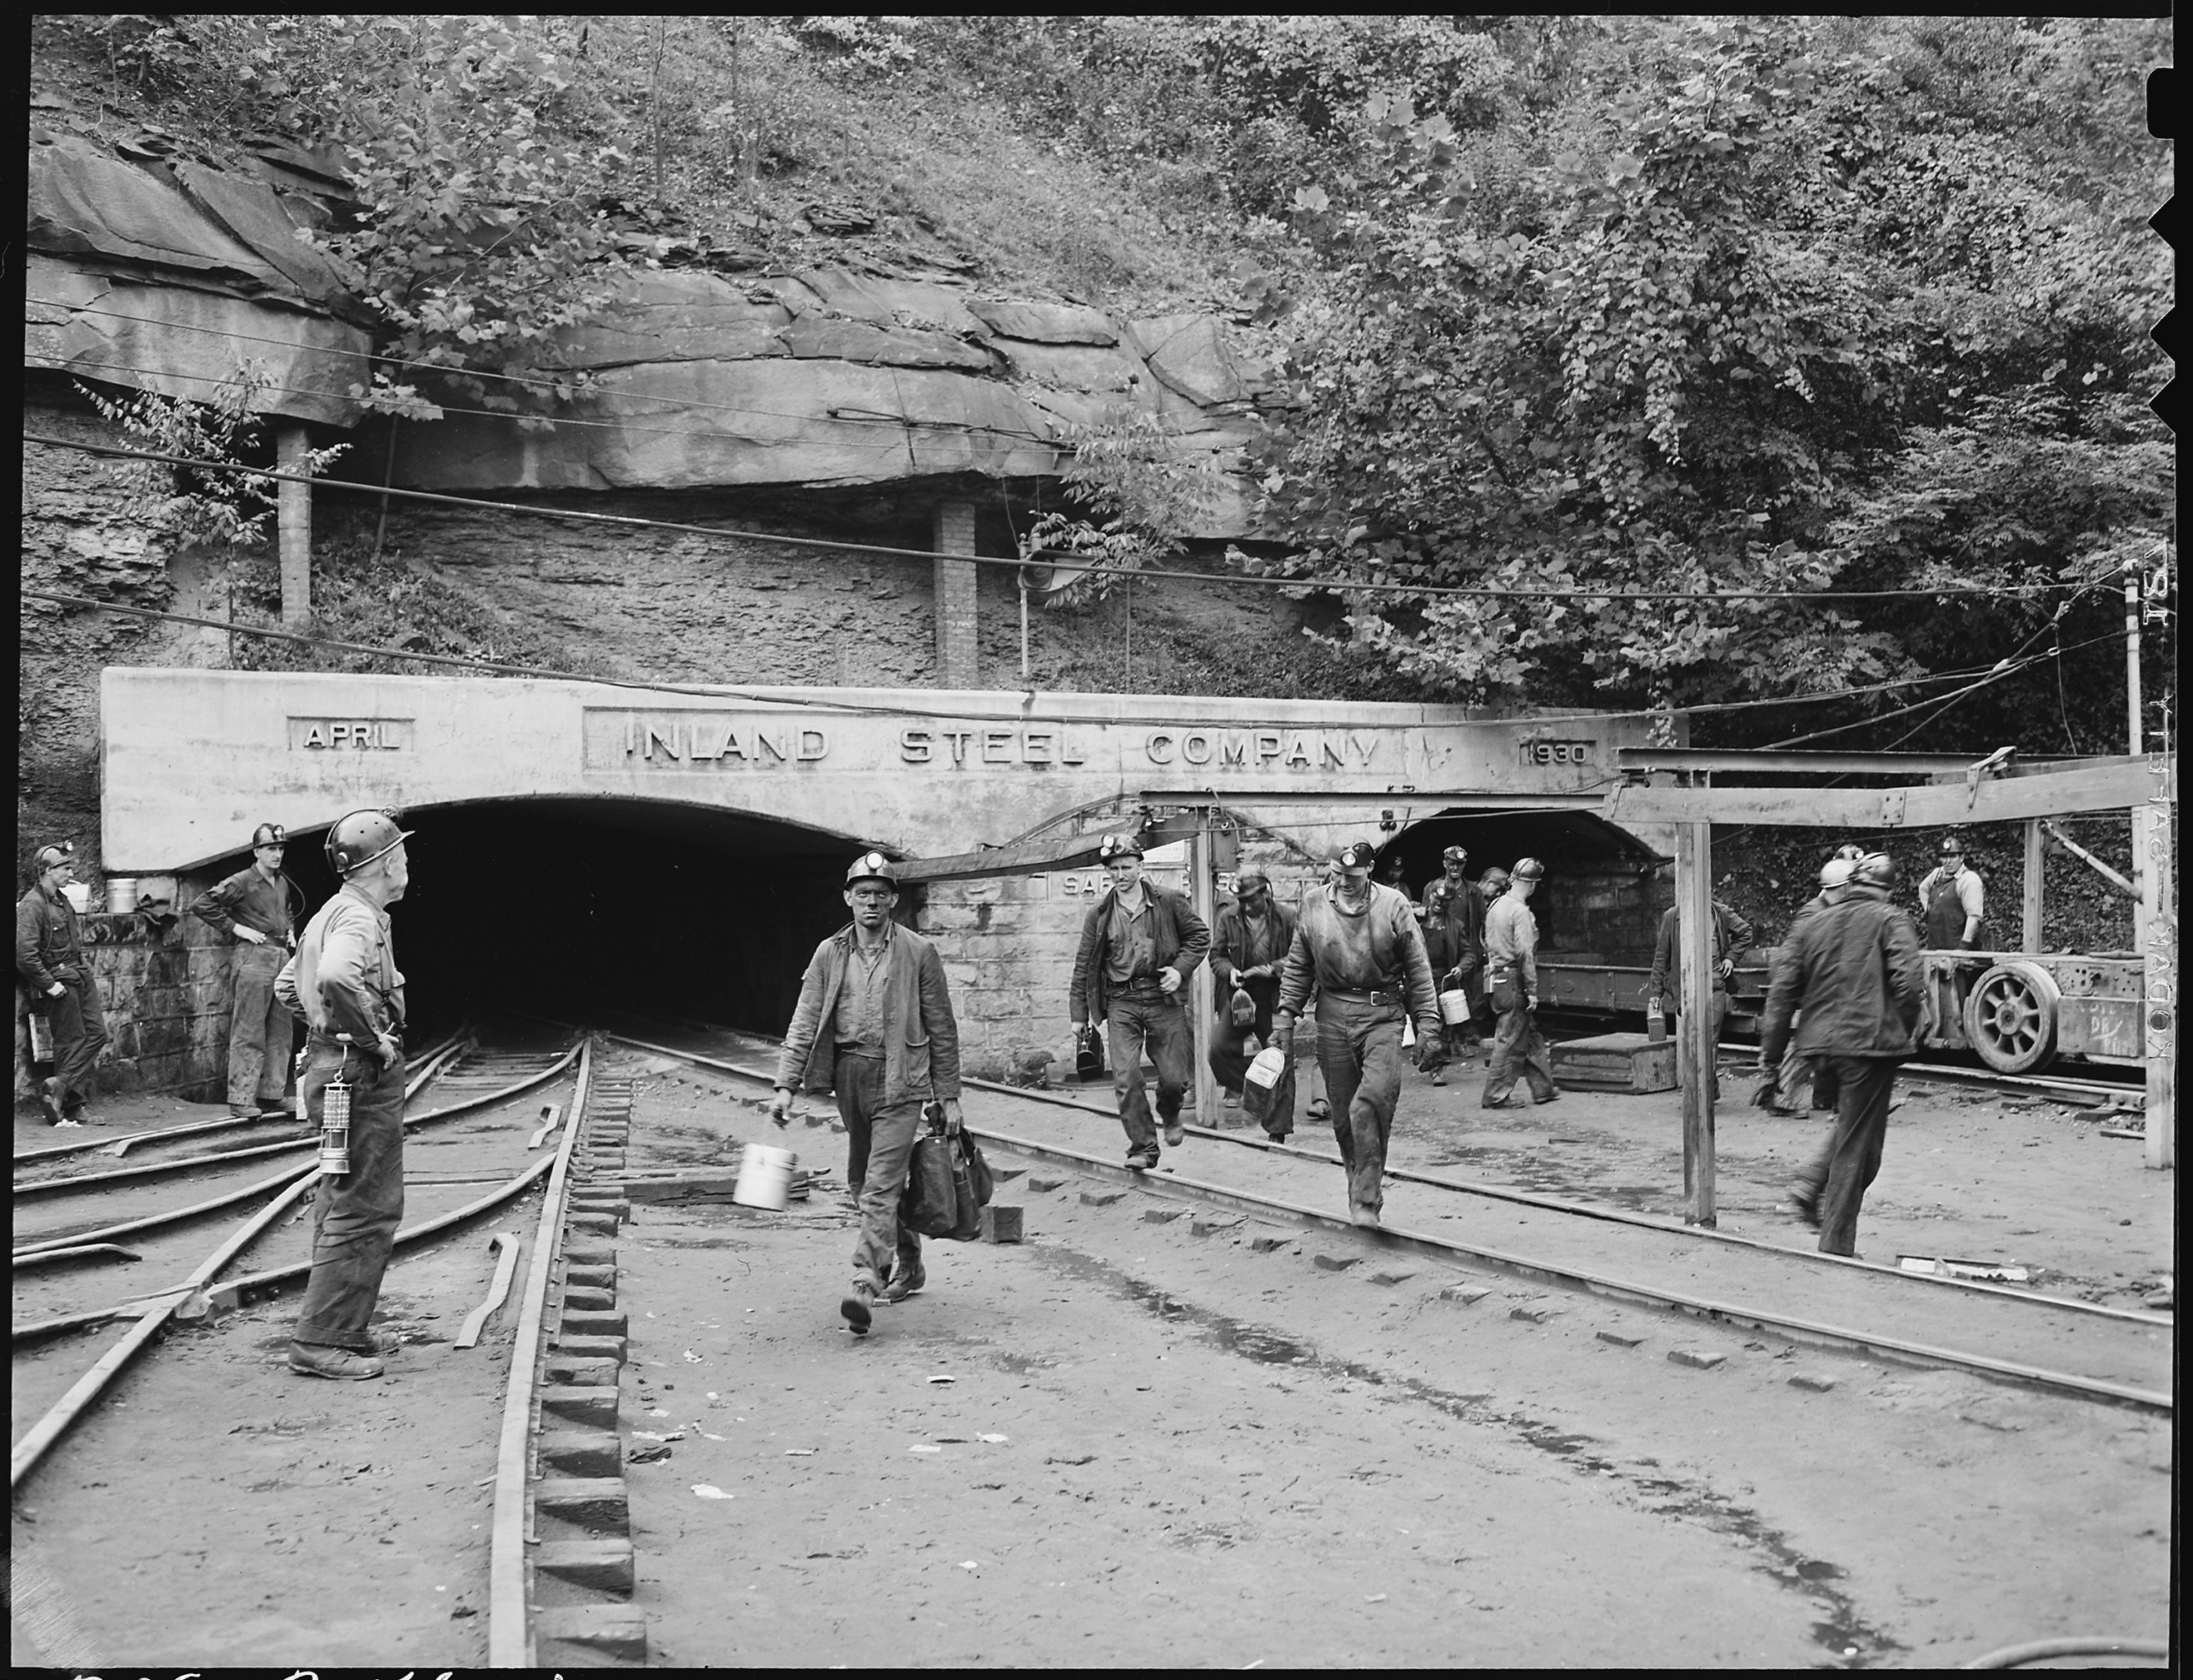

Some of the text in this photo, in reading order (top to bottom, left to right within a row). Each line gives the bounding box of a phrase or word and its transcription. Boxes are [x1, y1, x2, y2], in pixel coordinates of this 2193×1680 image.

[303, 723, 401, 749] APRIL
[625, 716, 1379, 766] INLAND STEEL COMPANY
[1528, 743, 1586, 766] 1930
